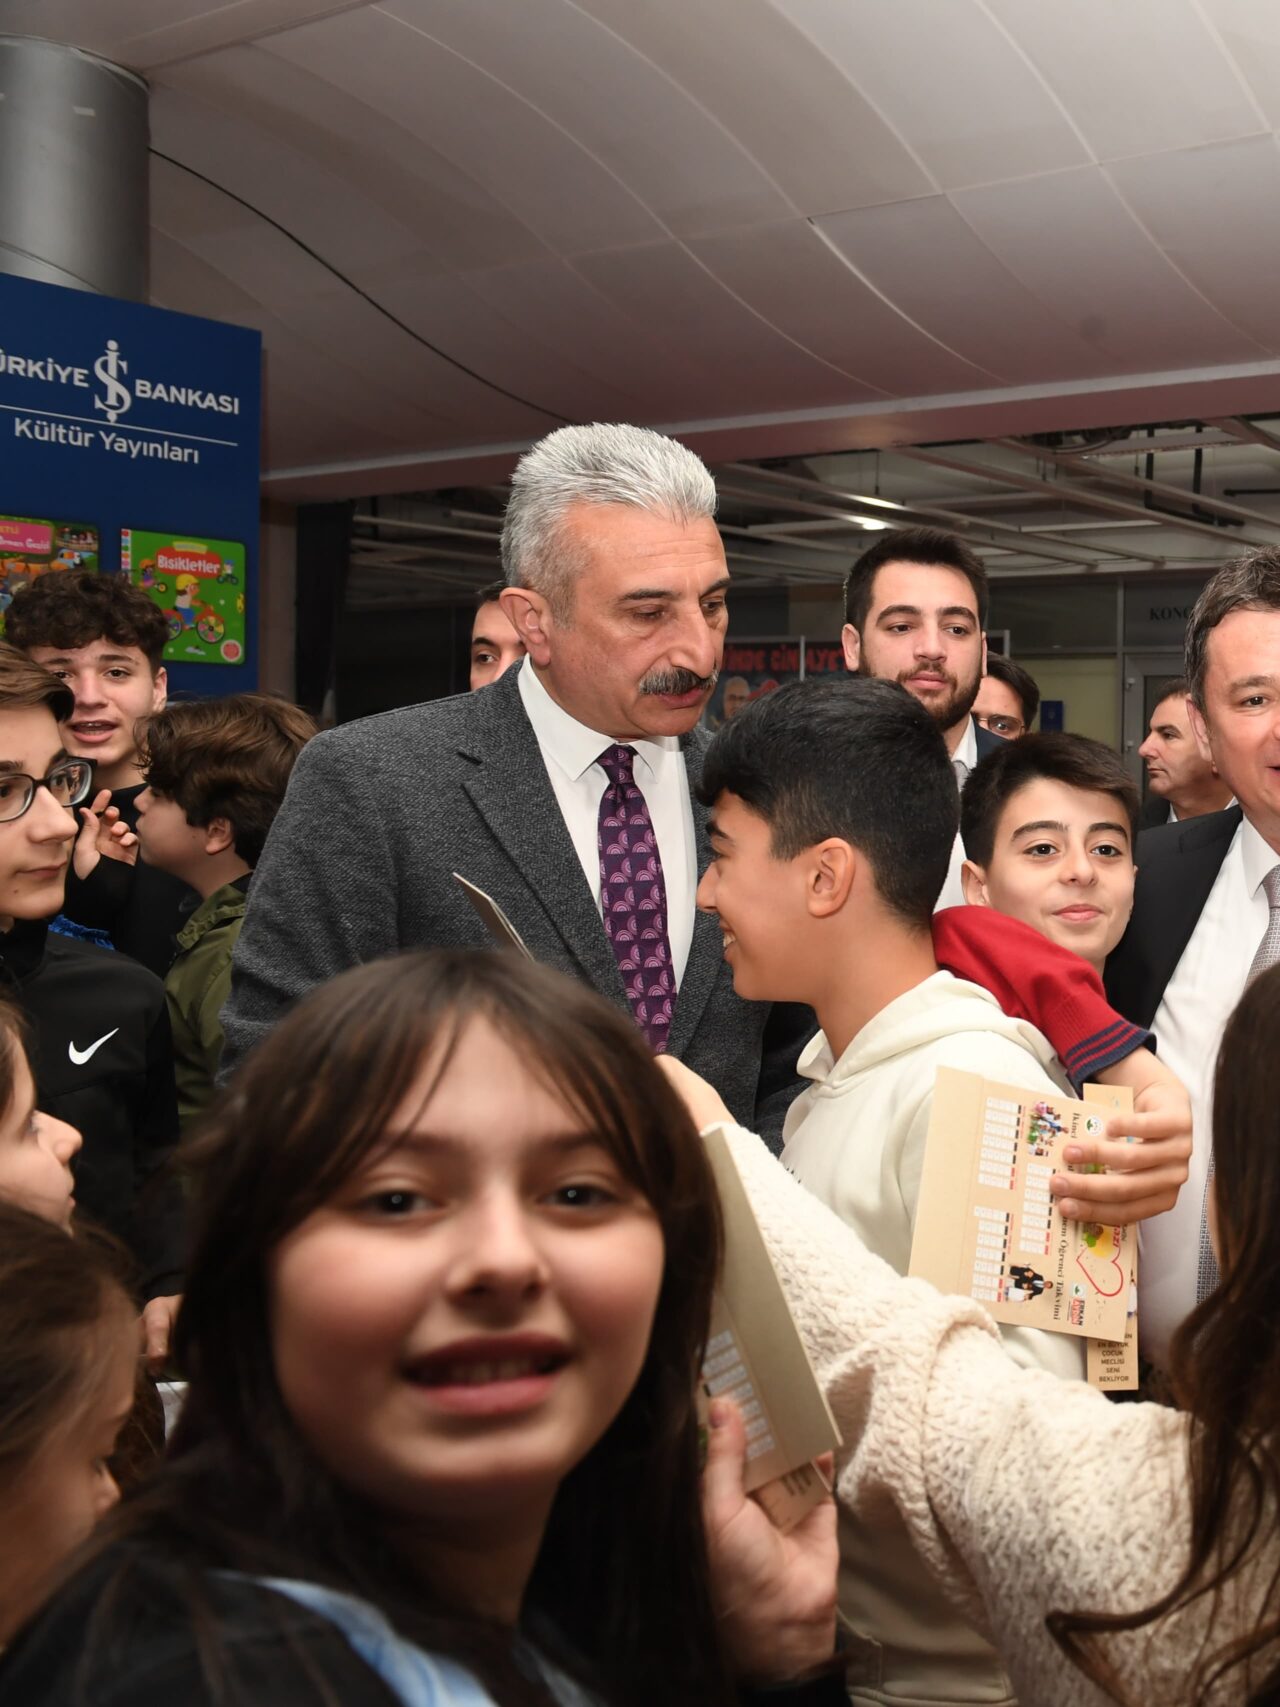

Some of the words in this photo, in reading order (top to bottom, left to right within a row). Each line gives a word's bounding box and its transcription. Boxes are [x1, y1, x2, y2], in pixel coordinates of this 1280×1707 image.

[135, 378, 240, 416] BANKASI
[14, 416, 95, 448] Kültür
[99, 430, 200, 464] Yayınları
[157, 554, 221, 574] Bisikletler
[1061, 1217, 1069, 1236] nem
[1053, 1280, 1064, 1321] Takvimi
